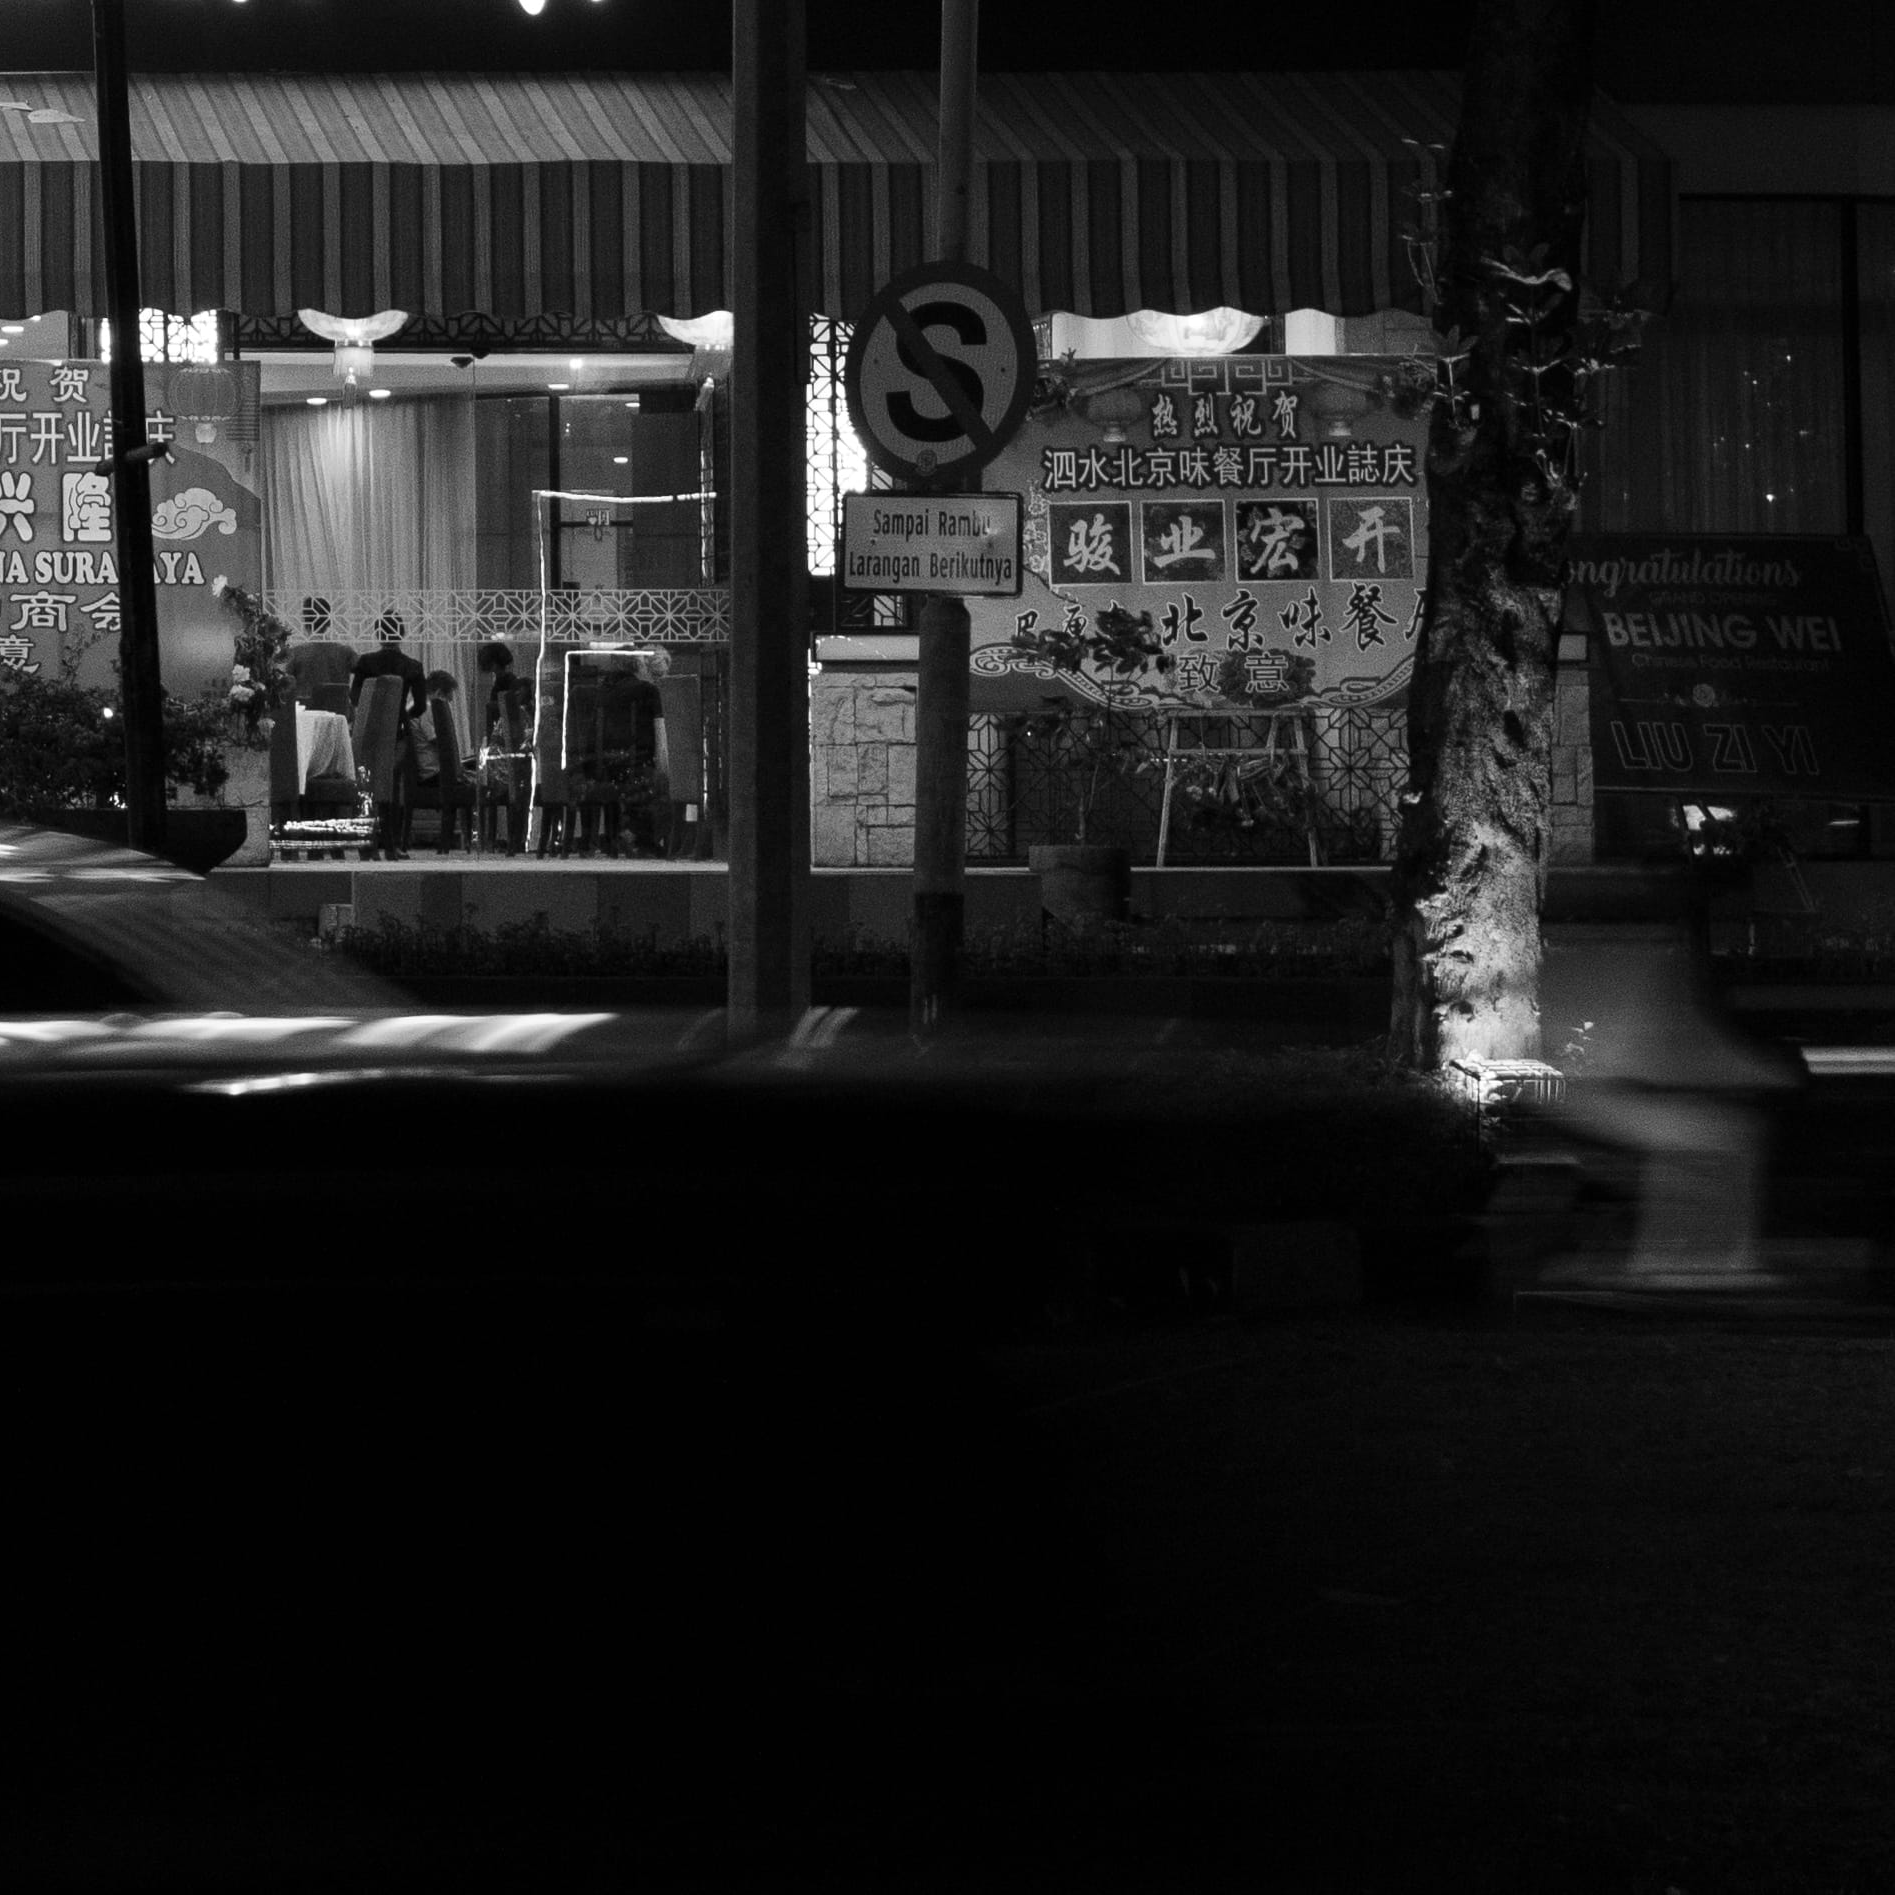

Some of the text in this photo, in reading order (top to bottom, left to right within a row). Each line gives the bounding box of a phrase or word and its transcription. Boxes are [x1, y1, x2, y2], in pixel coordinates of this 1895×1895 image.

[1152, 393, 1299, 438] 热烈祝贺
[1043, 447, 1416, 489] 泗水北京味餐厅开业誌庆
[873, 509, 991, 542] Sampai Rambu
[35, 550, 205, 584] SURAYA
[849, 552, 1012, 585] Larangan Berikutnya
[1567, 547, 1801, 598] ngratulations
[1602, 612, 1844, 652] BEIJING WEI
[1178, 652, 1288, 695] 致意
[1610, 720, 1820, 775] LIU ZI YI
